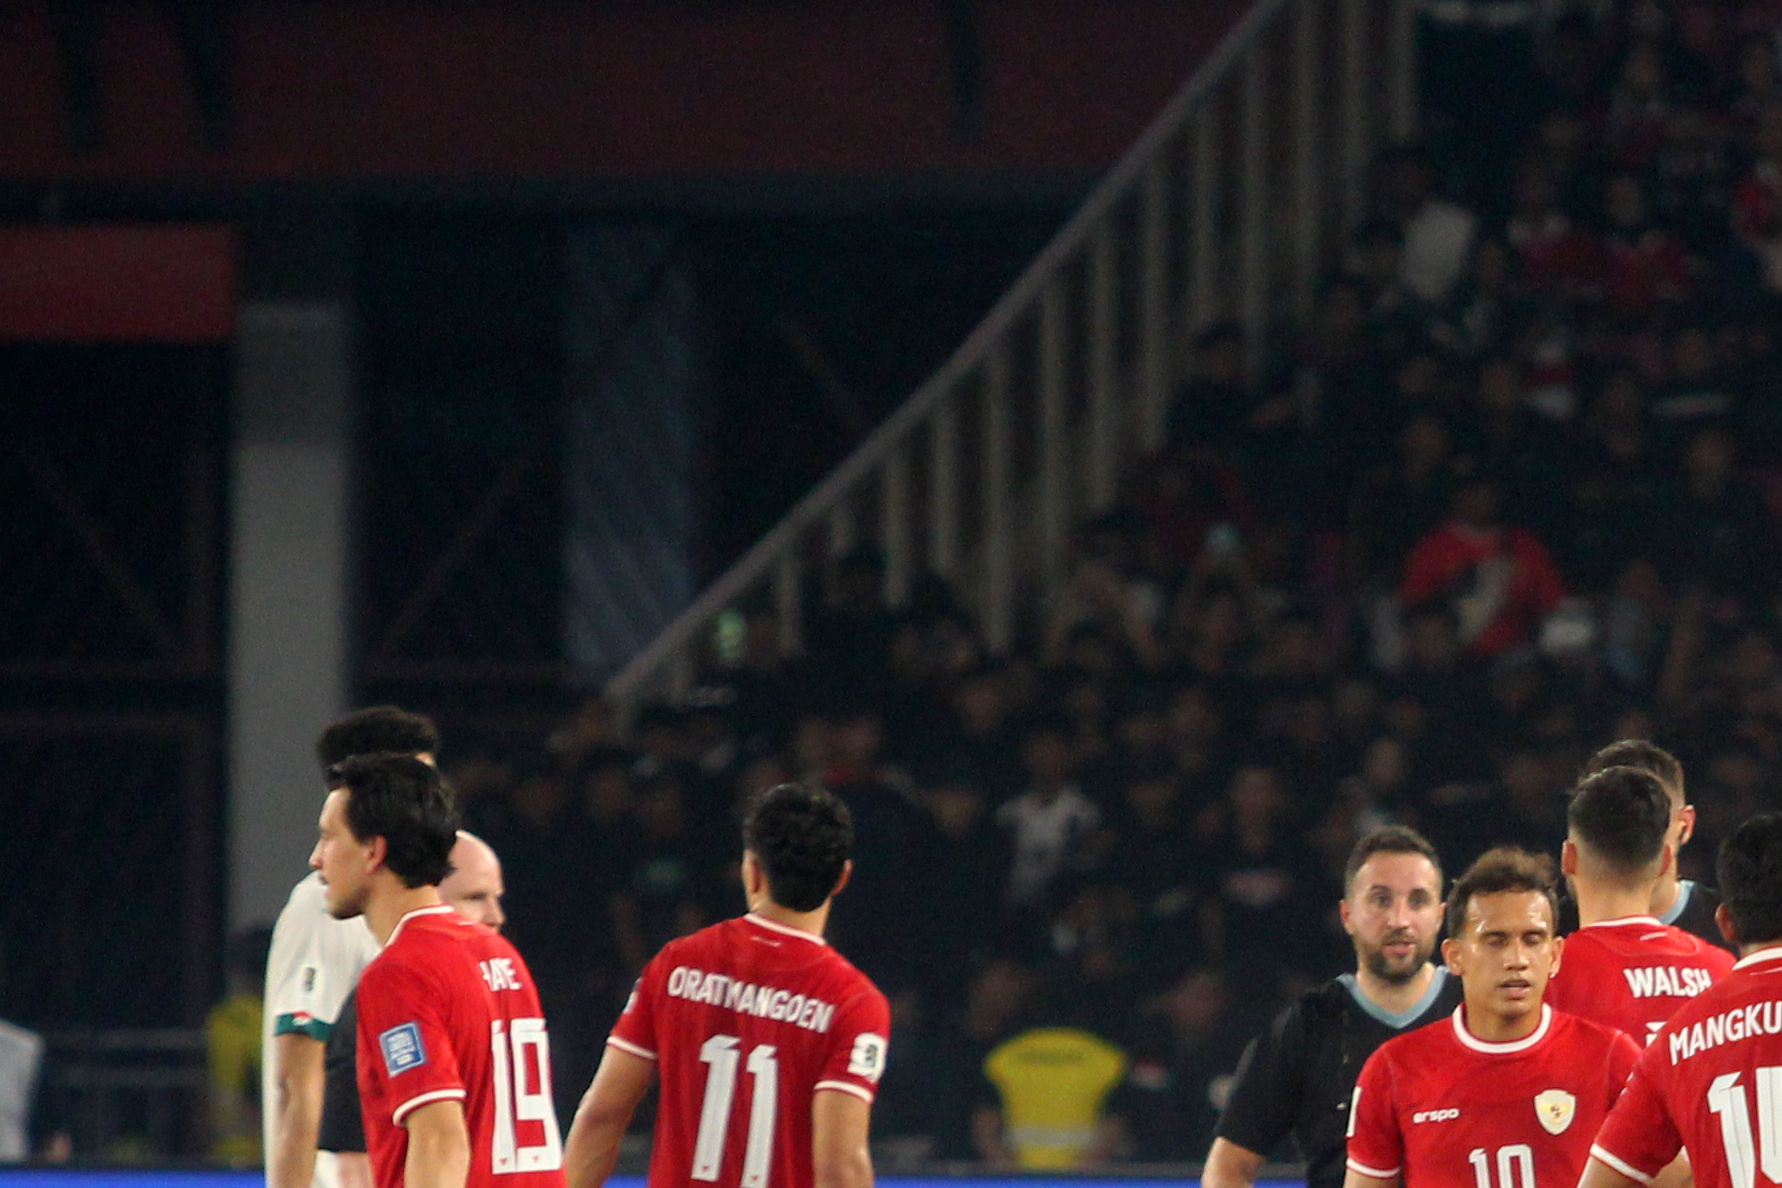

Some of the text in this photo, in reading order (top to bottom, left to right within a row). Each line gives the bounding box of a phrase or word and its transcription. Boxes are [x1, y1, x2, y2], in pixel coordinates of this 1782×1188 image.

[668, 966, 836, 1034] ORATMANGOEN
[1623, 966, 1713, 998] WALSH
[491, 1018, 562, 1174] 19
[1413, 1108, 1460, 1124] erspo
